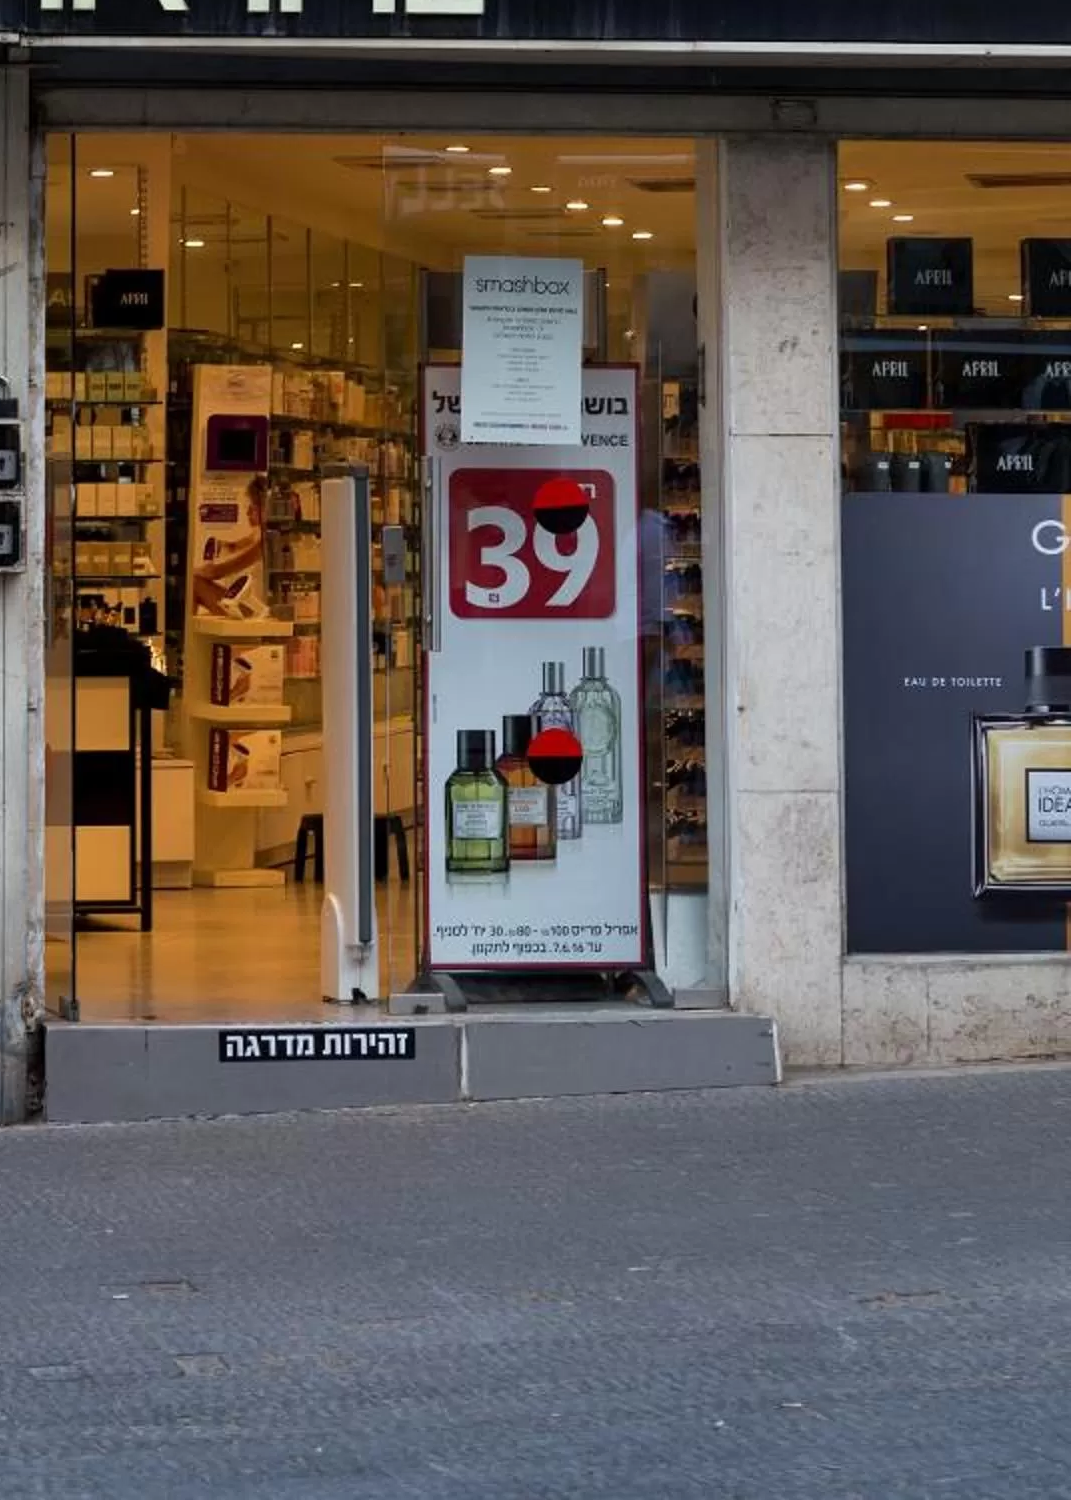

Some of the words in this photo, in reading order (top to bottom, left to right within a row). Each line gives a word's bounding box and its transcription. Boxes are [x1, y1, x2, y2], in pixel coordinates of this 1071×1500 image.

[475, 275, 570, 296] smashbox
[962, 360, 1001, 378] APRIL
[580, 432, 630, 448] VENCE
[465, 503, 600, 608] 39
[904, 677, 927, 688] EAU
[932, 677, 947, 688] DE
[951, 677, 1002, 688] TOILETTE
[225, 1034, 315, 1058] מדרגה
[322, 1033, 409, 1056] זהירות
